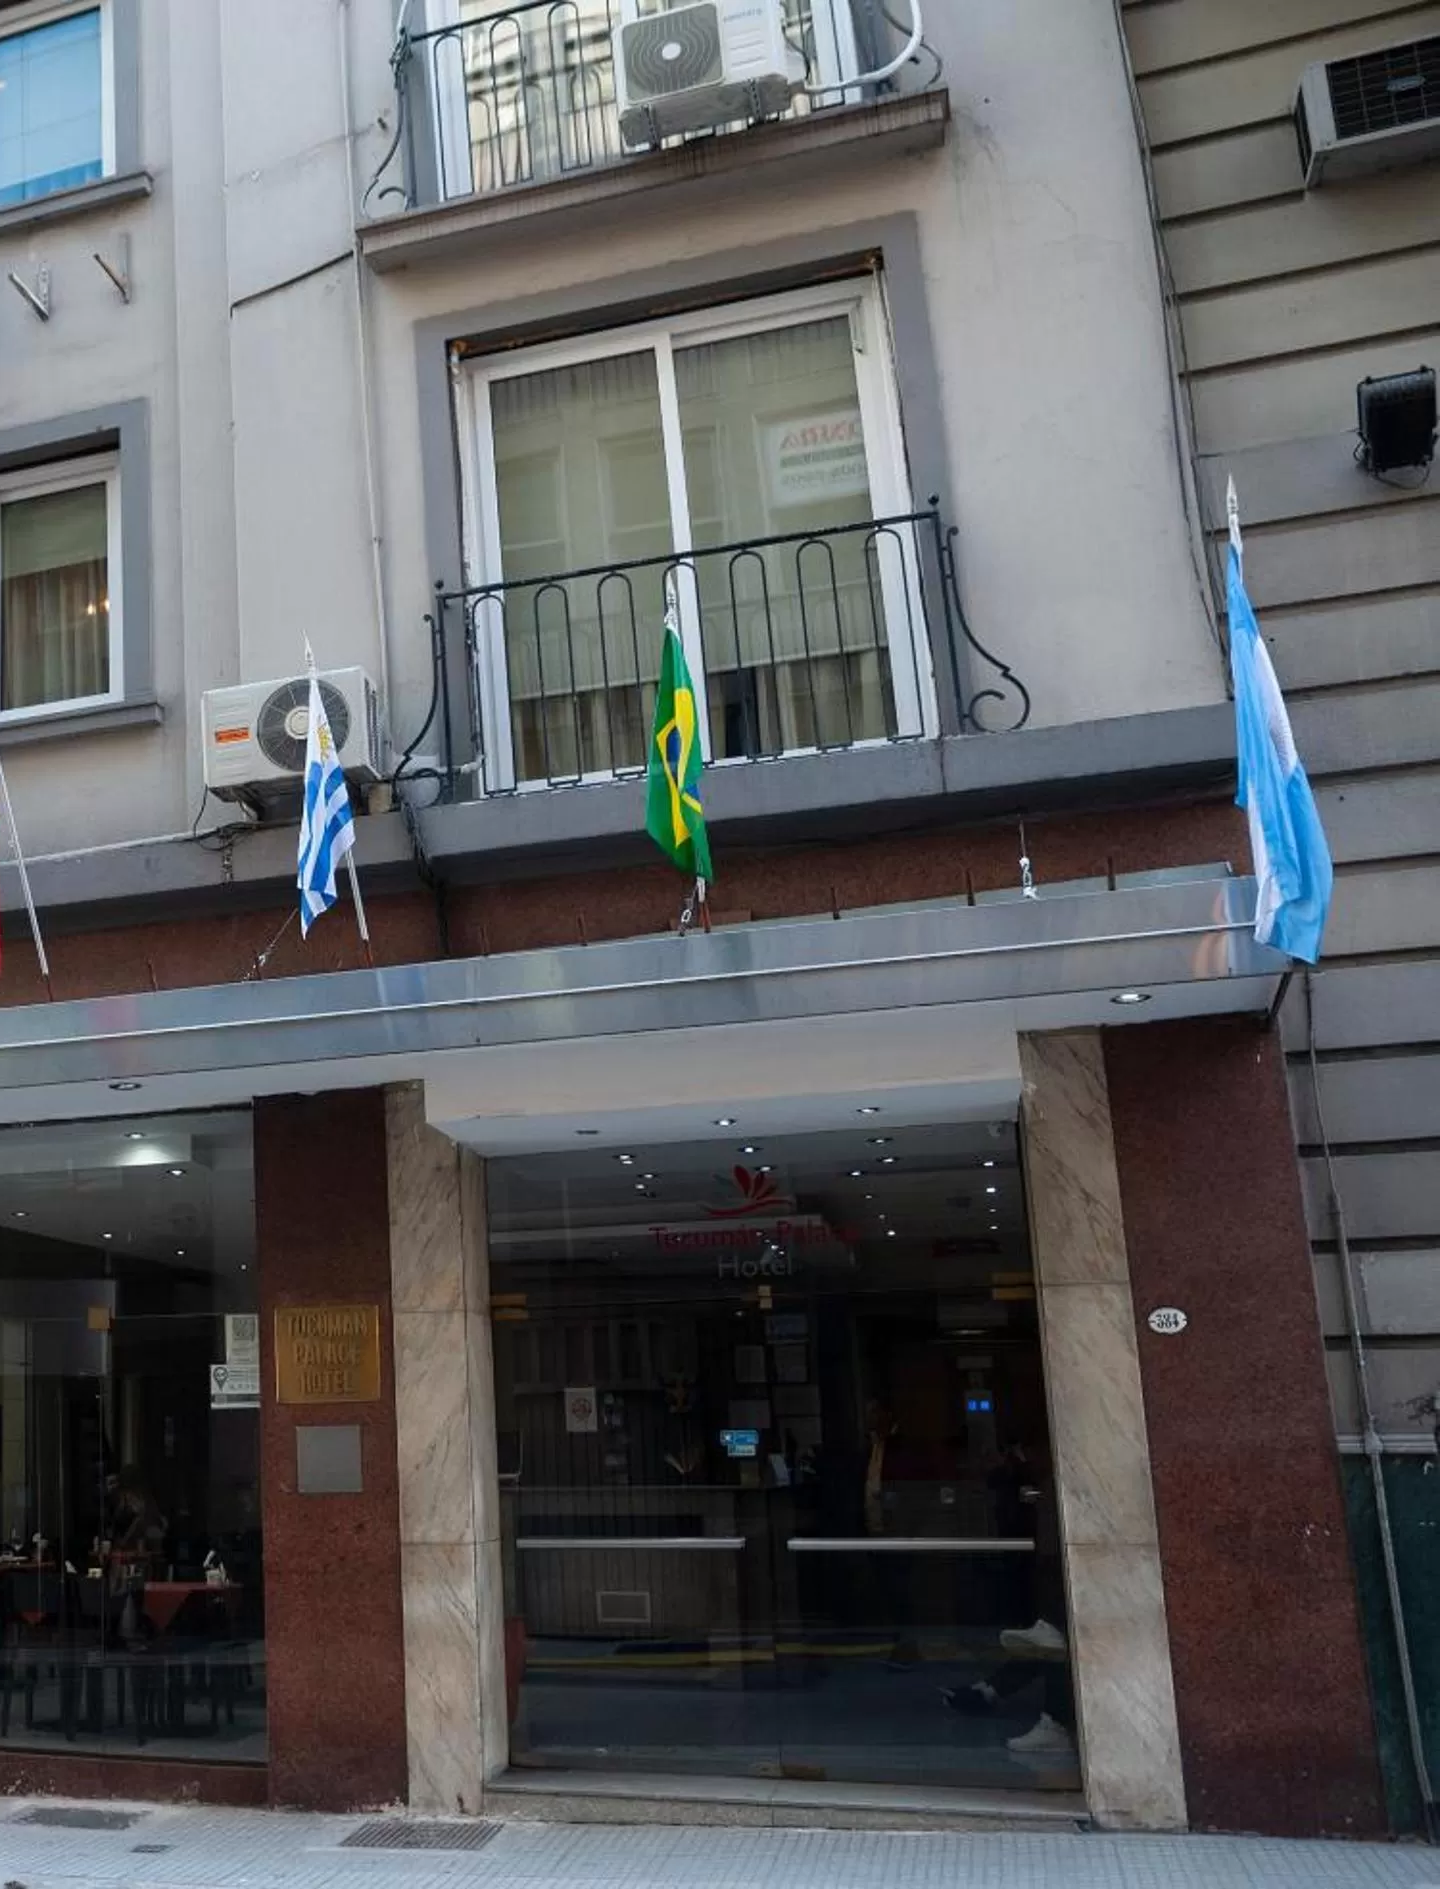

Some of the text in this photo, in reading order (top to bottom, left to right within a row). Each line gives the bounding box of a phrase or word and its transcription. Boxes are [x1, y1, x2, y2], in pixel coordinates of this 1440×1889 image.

[776, 1218, 860, 1243] Pala
[717, 1252, 793, 1278] Hotel
[299, 1368, 356, 1393] HOTEL
